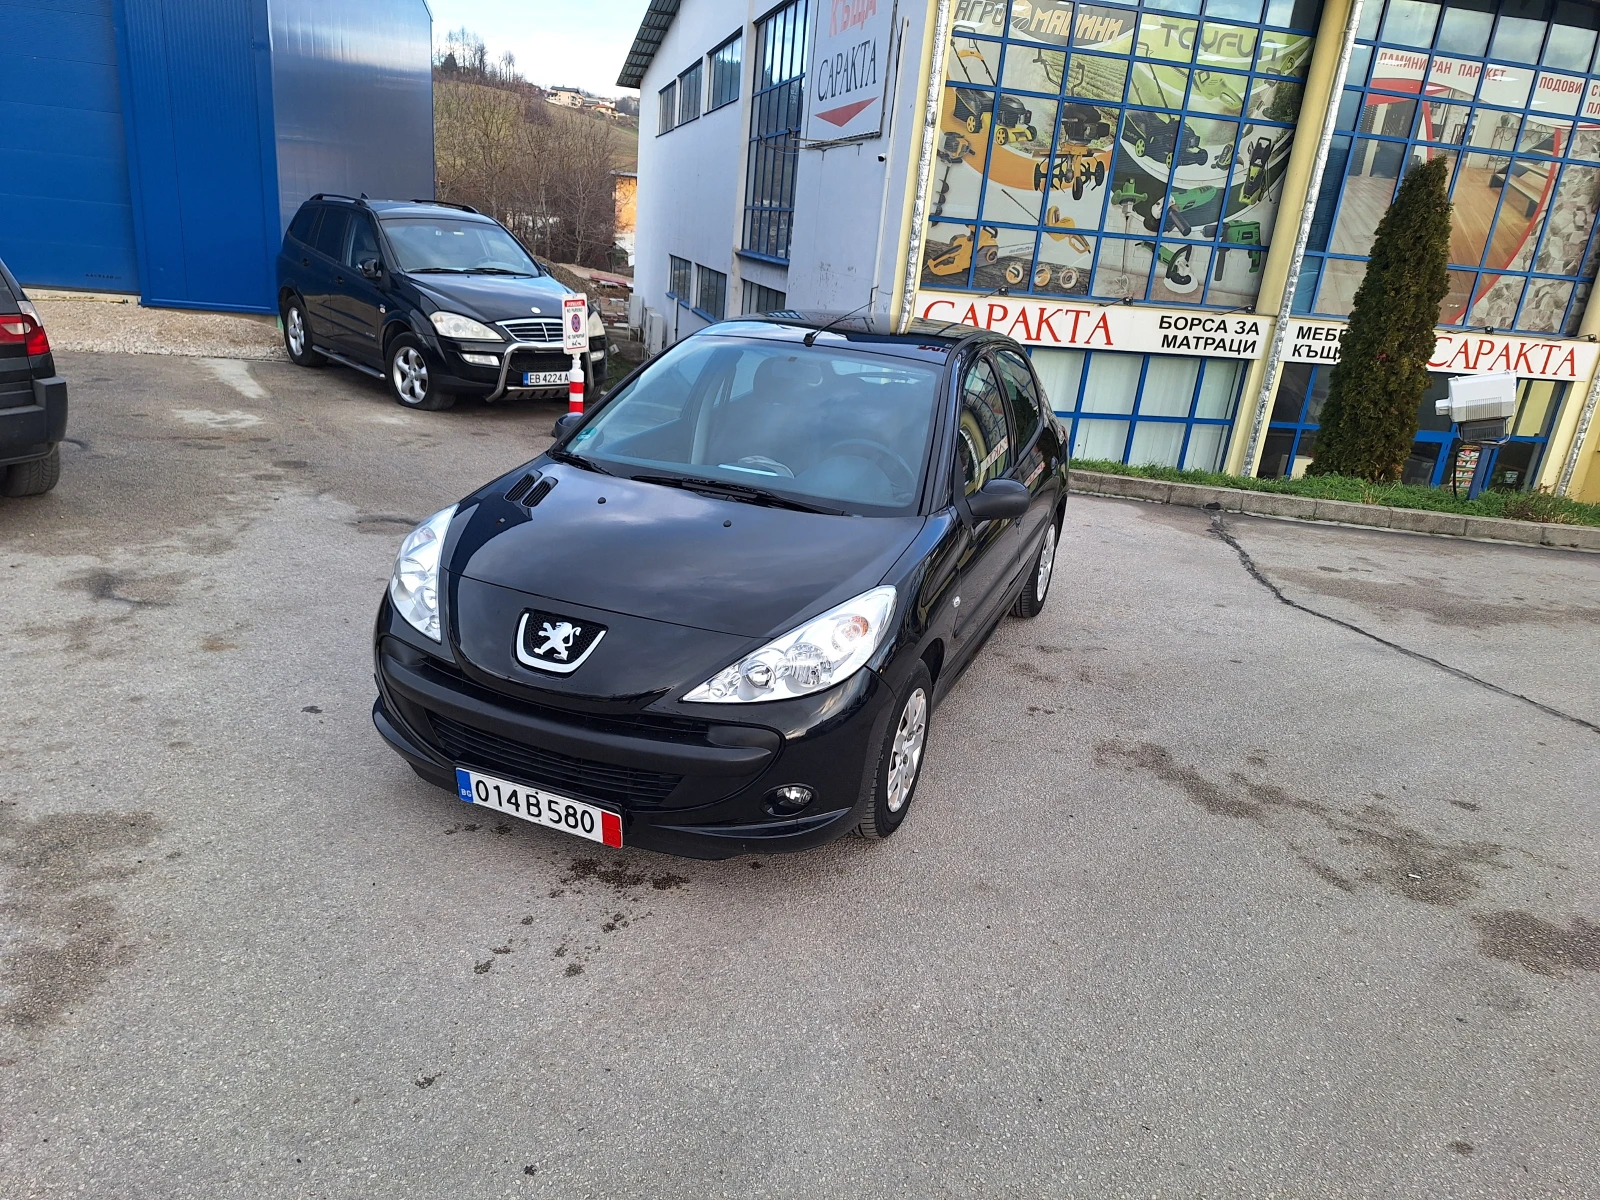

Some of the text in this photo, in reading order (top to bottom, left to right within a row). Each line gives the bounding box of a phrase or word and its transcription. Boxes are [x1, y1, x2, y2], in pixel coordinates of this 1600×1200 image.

[953, 0, 1123, 42] АГРО МАШИНИ
[818, 36, 877, 101] САРАКТА
[1457, 63, 1507, 82] ПАРКЕТ
[1539, 77, 1583, 94] ПОДОВИ
[1158, 315, 1260, 336] БОРСА ЗА
[1161, 334, 1257, 355] МАТРАЦИ
[1292, 343, 1341, 362] КЪЩ
[1426, 336, 1577, 377] САРАКТА
[542, 373, 562, 383] 4224
[461, 788, 472, 798] BG
